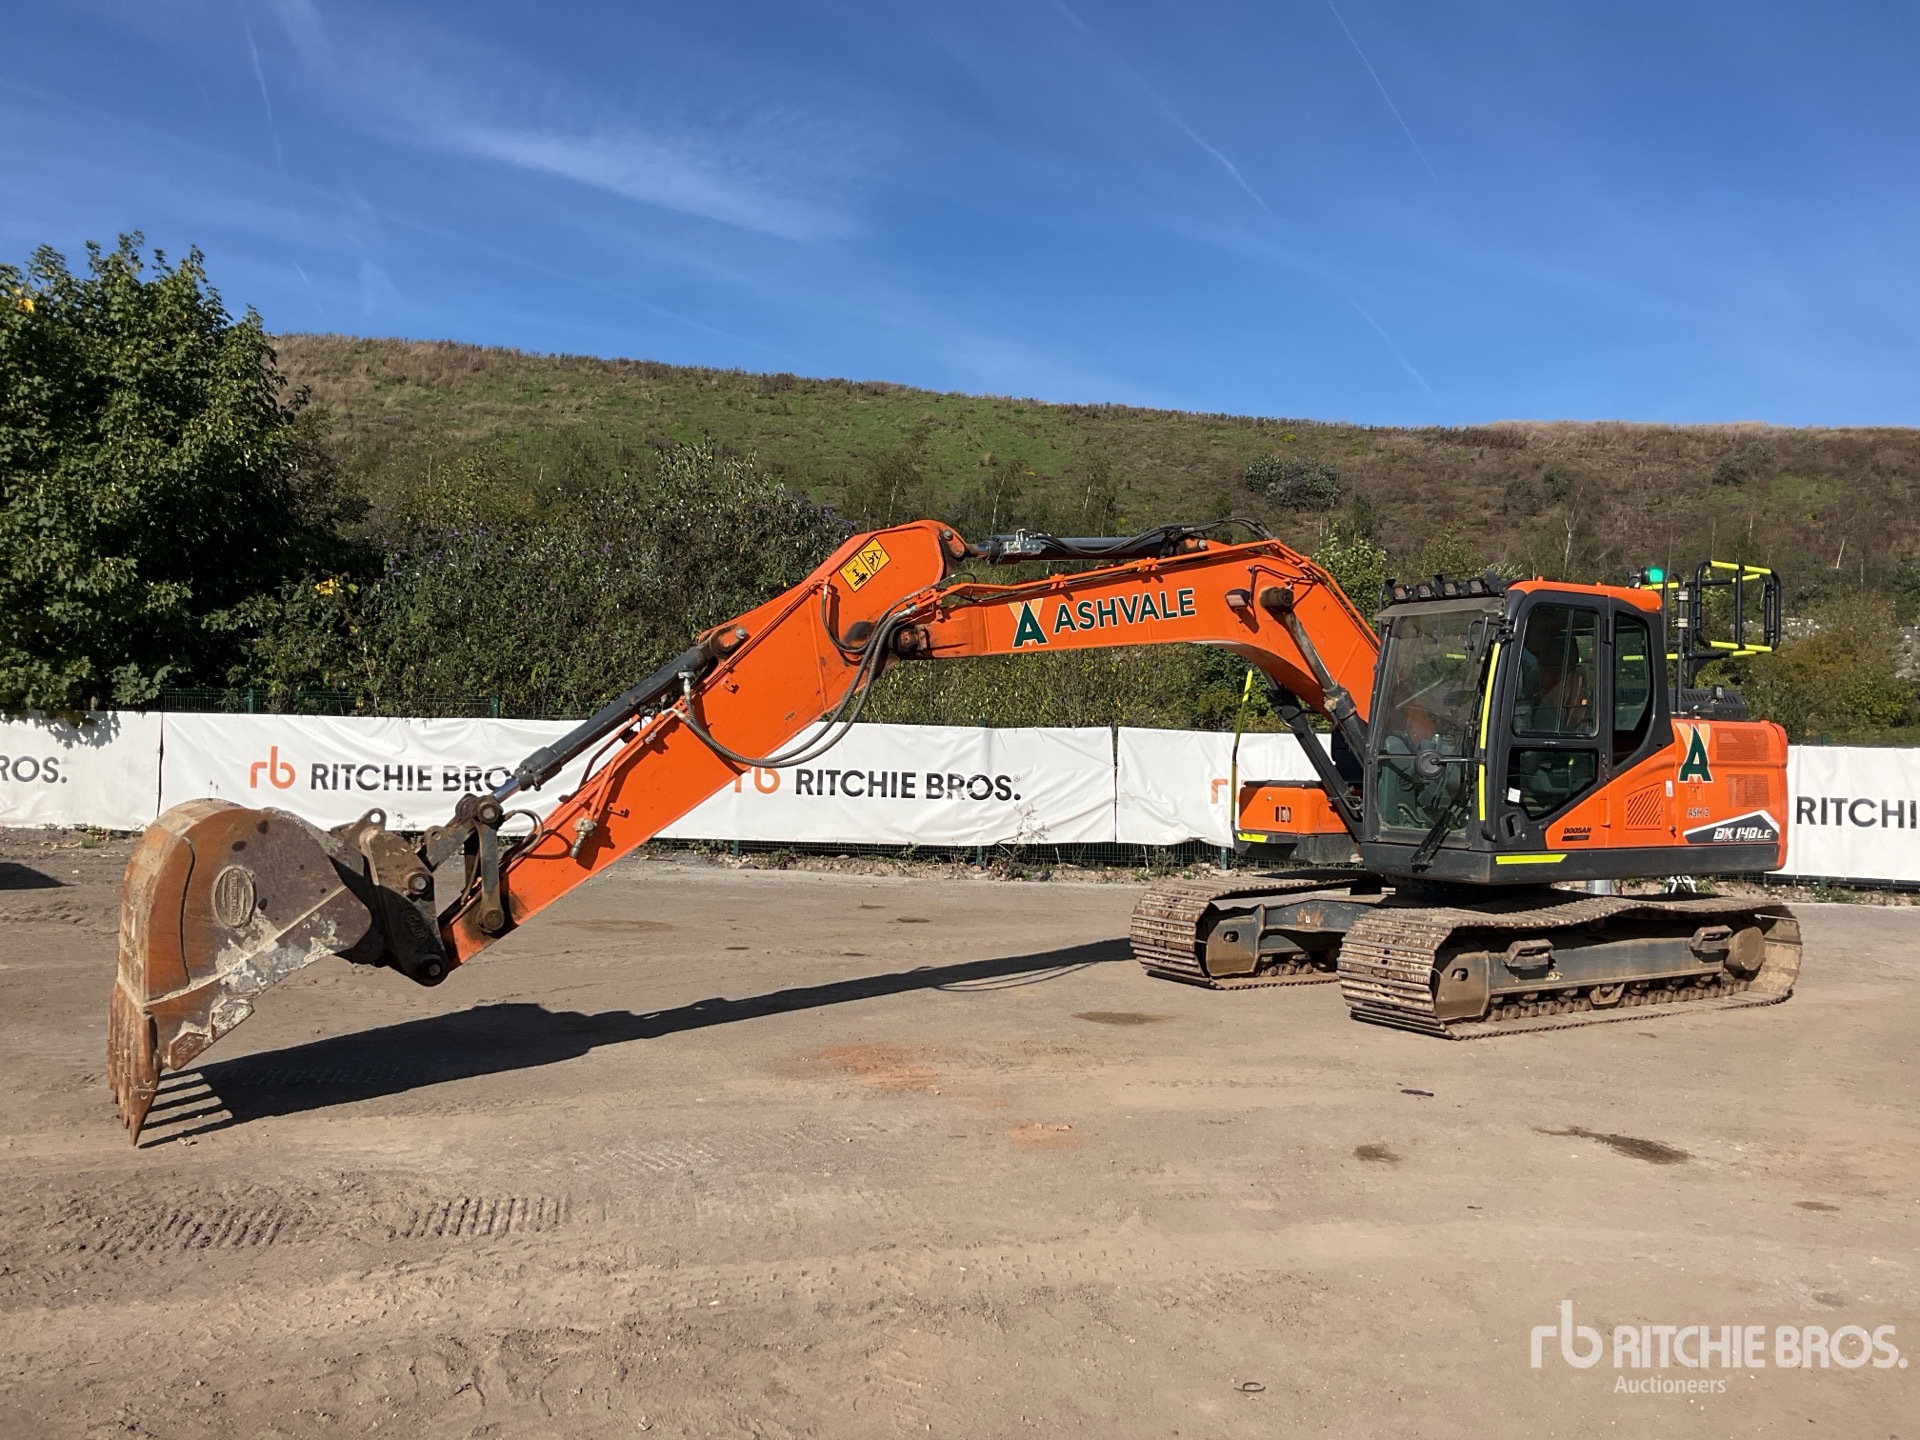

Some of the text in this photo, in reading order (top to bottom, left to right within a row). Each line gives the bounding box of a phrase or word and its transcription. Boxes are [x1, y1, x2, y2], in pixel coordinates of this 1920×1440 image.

[1053, 588, 1196, 634] ASHVALE
[0, 755, 68, 783] ROS.
[310, 763, 516, 792] RITCHIE BRO
[795, 768, 1021, 801] RITCHIE BROS.
[1796, 796, 1917, 829] RITCHI
